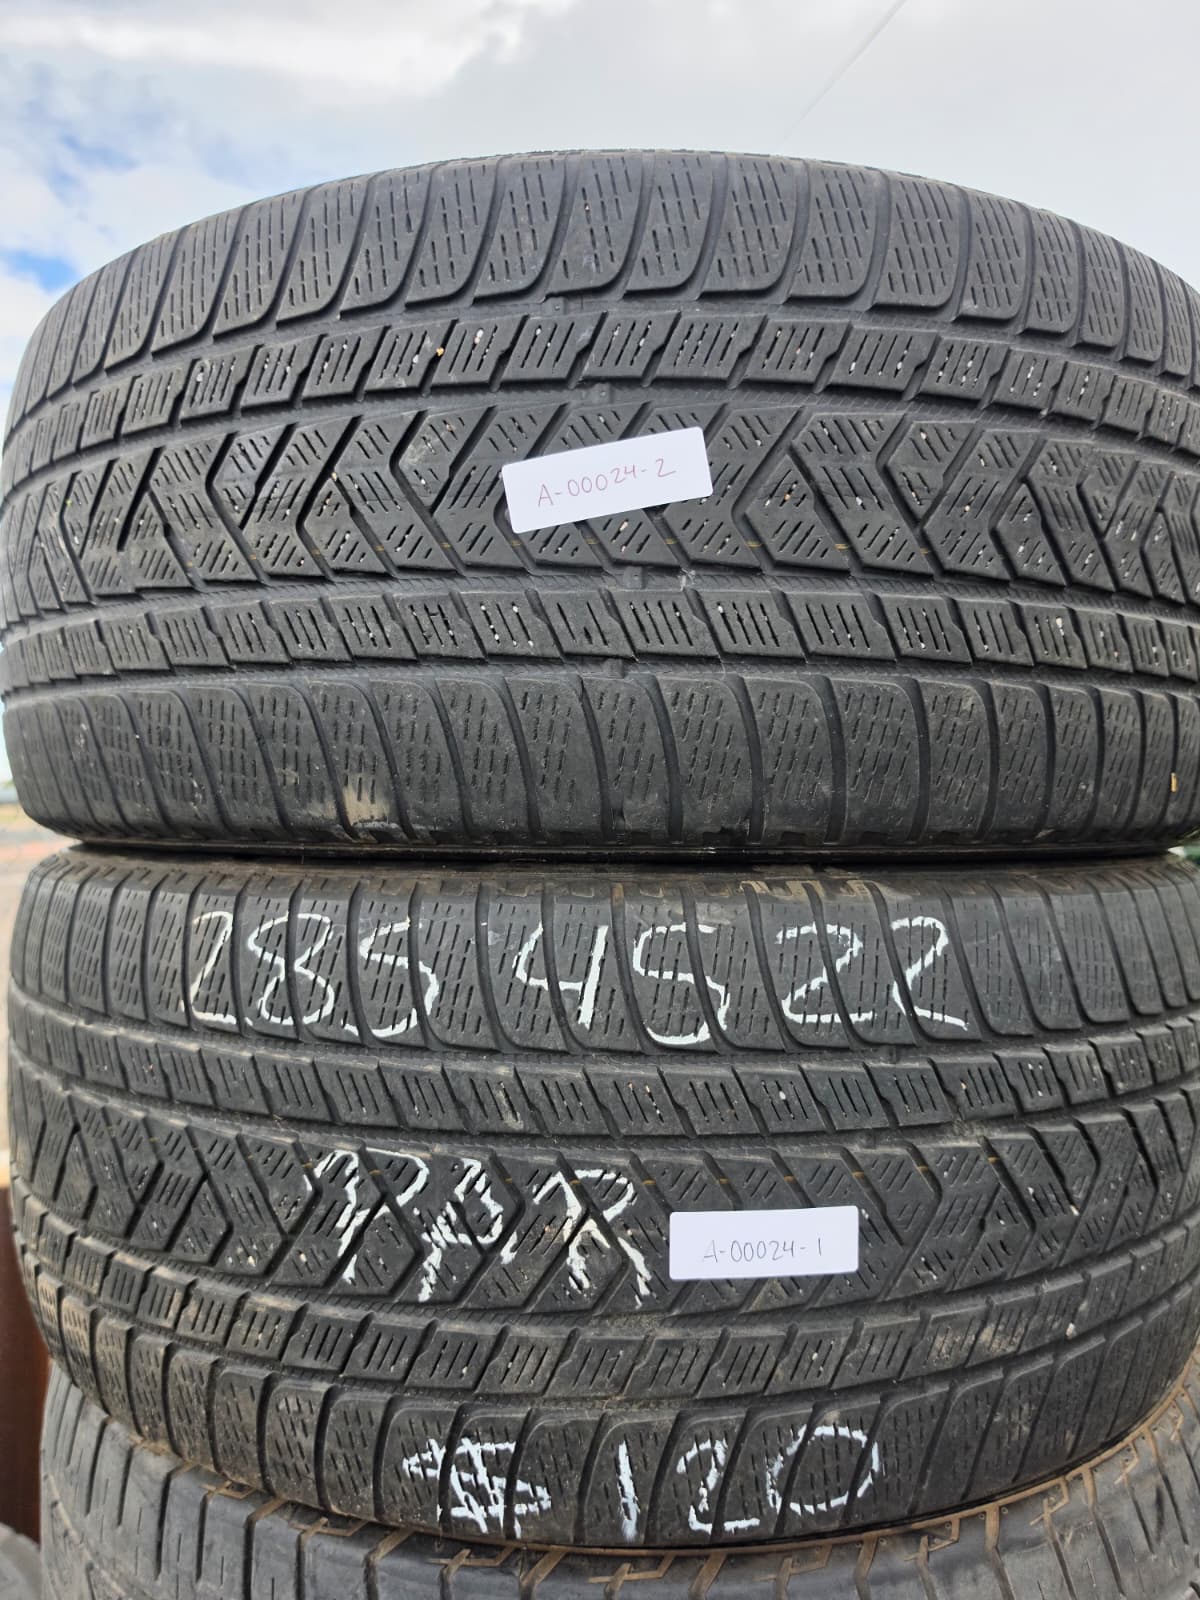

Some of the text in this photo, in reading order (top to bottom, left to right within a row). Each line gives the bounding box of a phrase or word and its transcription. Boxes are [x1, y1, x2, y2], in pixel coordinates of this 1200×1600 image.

[537, 457, 677, 508] A-00024-2
[181, 910, 969, 1045] 285 45 22
[703, 1236, 823, 1264] A-00024-1
